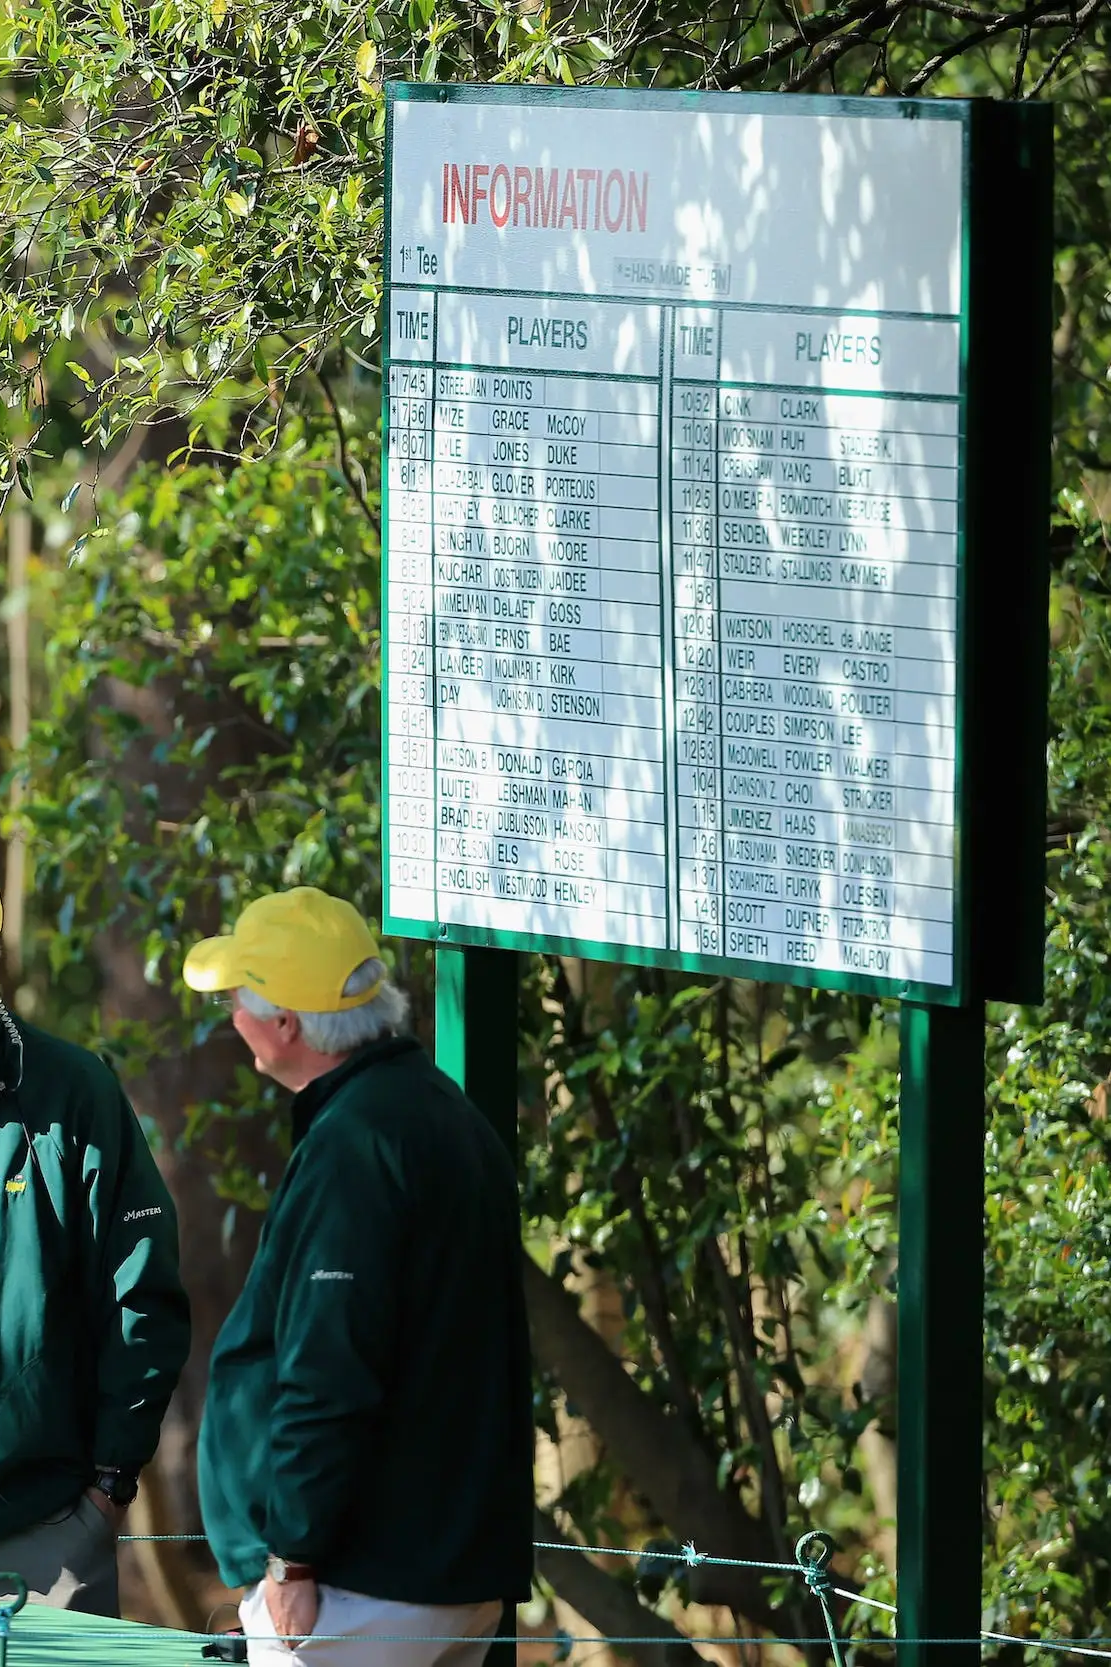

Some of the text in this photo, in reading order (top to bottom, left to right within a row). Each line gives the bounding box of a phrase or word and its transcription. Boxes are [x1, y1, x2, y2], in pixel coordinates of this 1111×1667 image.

[442, 163, 649, 233] INFORMATION
[417, 246, 438, 275] Tee
[660, 264, 690, 286] MADE
[396, 311, 429, 341] TIME
[507, 315, 588, 350] PLAYERS
[680, 326, 714, 356] TIME
[796, 332, 881, 365] PLAYERS
[494, 379, 532, 400] POINTS
[439, 407, 464, 427] MIZE
[493, 409, 529, 430] GRACE
[548, 414, 586, 436] McCOY
[725, 396, 751, 416] CINK
[781, 398, 819, 421] CLARK
[493, 441, 529, 462] JONES
[548, 445, 577, 465] DUKE
[723, 427, 773, 449] WOOSNAM
[781, 431, 805, 451] HUH
[492, 473, 534, 494] GLOVER
[546, 476, 595, 499] PORTEOUS
[724, 458, 772, 480] CRENSHAW
[781, 462, 811, 483] YANG
[840, 466, 871, 488] BLIXT
[546, 508, 590, 530] CLARKE
[781, 494, 832, 517] BOWDITCH
[440, 531, 472, 551] SINGH
[494, 537, 530, 556] BJORN
[548, 541, 588, 562] MOORE
[724, 522, 769, 545] SENDEN
[781, 527, 831, 548] WEEKLEY
[840, 531, 866, 552] LYNN
[439, 562, 586, 592] KUCHAR OOSTHUIZEN JAIDEE
[724, 552, 761, 575] STADLER
[781, 559, 832, 582] STALLINGS
[840, 563, 887, 586] KAYMER
[439, 593, 486, 614] IMMELMAN
[494, 597, 535, 618] DeLAET
[550, 602, 581, 624] GOSS
[495, 628, 530, 650] ERNST
[550, 633, 570, 652] BAE
[727, 618, 771, 639] WATSON
[783, 622, 834, 646] HORSCHEL
[841, 628, 853, 647] de
[857, 629, 892, 652] JONGE
[440, 653, 484, 676] LANGER
[495, 658, 533, 680] MOLINARI
[550, 664, 576, 685] KIRK
[727, 649, 755, 670] WEIR
[784, 654, 820, 676] EVERY
[842, 659, 889, 683] CASTRO
[441, 685, 460, 704] DAY
[497, 688, 534, 711] JOHNSON
[552, 693, 600, 716] STENSON
[724, 679, 773, 703] CABRERA
[784, 685, 833, 709] WOODLAND
[841, 693, 891, 715] POULTER
[726, 712, 775, 736] COUPLES
[784, 716, 834, 741] SIMPSON
[842, 725, 862, 745] LEE
[442, 746, 477, 768] WATSON
[498, 753, 542, 775] DONALD
[552, 758, 593, 781] GARCIA
[728, 744, 777, 769] McDOWELL
[786, 750, 832, 772] FOWLER
[844, 756, 890, 779] WALKER
[442, 777, 479, 798] LUITEN
[498, 781, 547, 806] LEISHMAN
[552, 790, 592, 811] MAHAN
[728, 774, 769, 798] JOHNSON
[785, 782, 813, 804] CHOI
[843, 788, 892, 810] STRICKER
[442, 806, 490, 831] BRADLEY
[498, 812, 547, 836] DUBUISSON
[555, 820, 601, 843] HANSON
[728, 808, 772, 831] JIMENEZ
[785, 815, 816, 835] HAAS
[441, 836, 490, 860] MCKELSON
[498, 844, 518, 864] ELS
[555, 850, 584, 872] ROSE
[728, 838, 777, 864] MATSUYAMA
[786, 845, 835, 870] SNEDEKER
[843, 852, 892, 877] DONALDSON
[442, 868, 490, 891] ENGLISH
[498, 874, 547, 898] WESTWOOD
[555, 881, 597, 905] HENLEY
[729, 870, 778, 895] SCHWARTZEL
[786, 876, 821, 899] FURYK
[844, 884, 887, 907] OLESEN
[728, 902, 765, 924] SCOTT
[786, 909, 829, 933] DUFNER
[843, 917, 890, 941] FITZPATRICK
[730, 933, 768, 956] SPIETH
[787, 941, 816, 963] REED
[844, 946, 890, 971] McILROY
